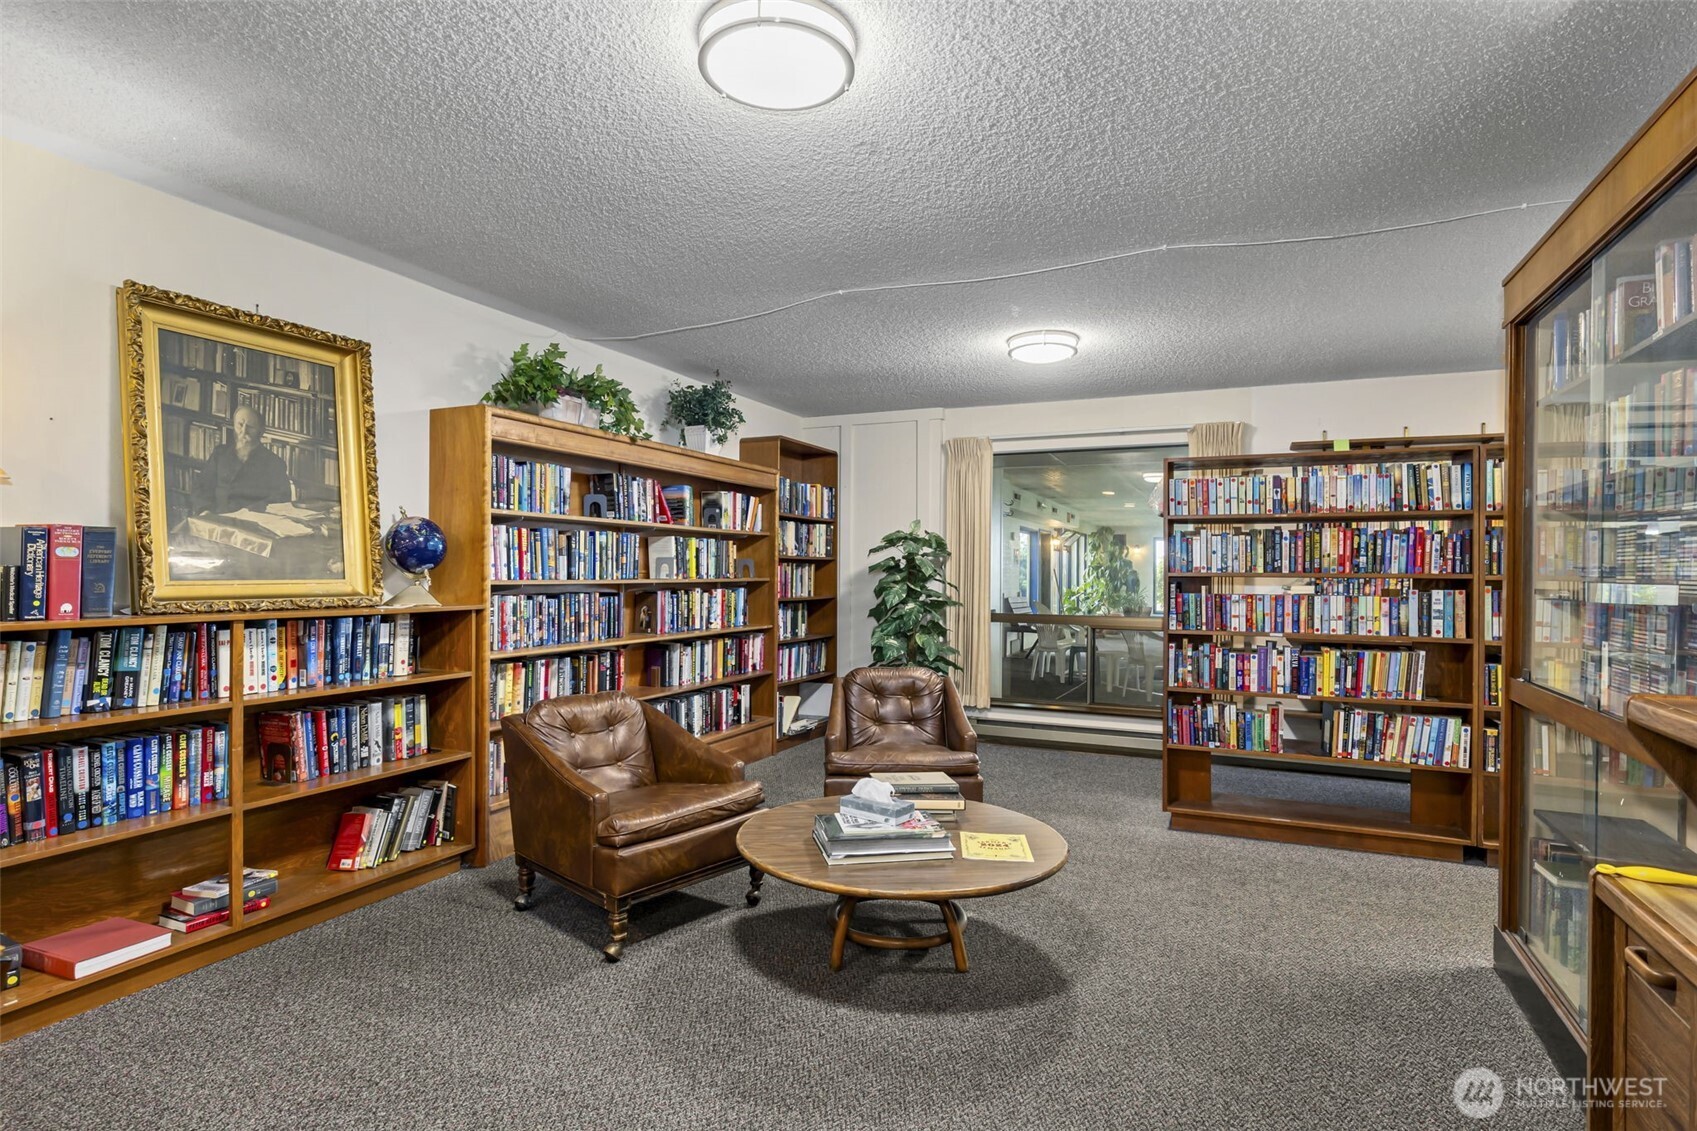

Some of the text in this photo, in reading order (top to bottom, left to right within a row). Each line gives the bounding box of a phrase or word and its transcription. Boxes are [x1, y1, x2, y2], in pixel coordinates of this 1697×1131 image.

[24, 543, 36, 576] Dictionary
[35, 539, 46, 570] American
[33, 571, 44, 598] Heritage
[97, 634, 112, 677] TOM CLANCY
[129, 633, 139, 668] TOM CLANCY
[133, 745, 142, 789] CLIVE CUSSLER
[419, 795, 430, 816] FLYING
